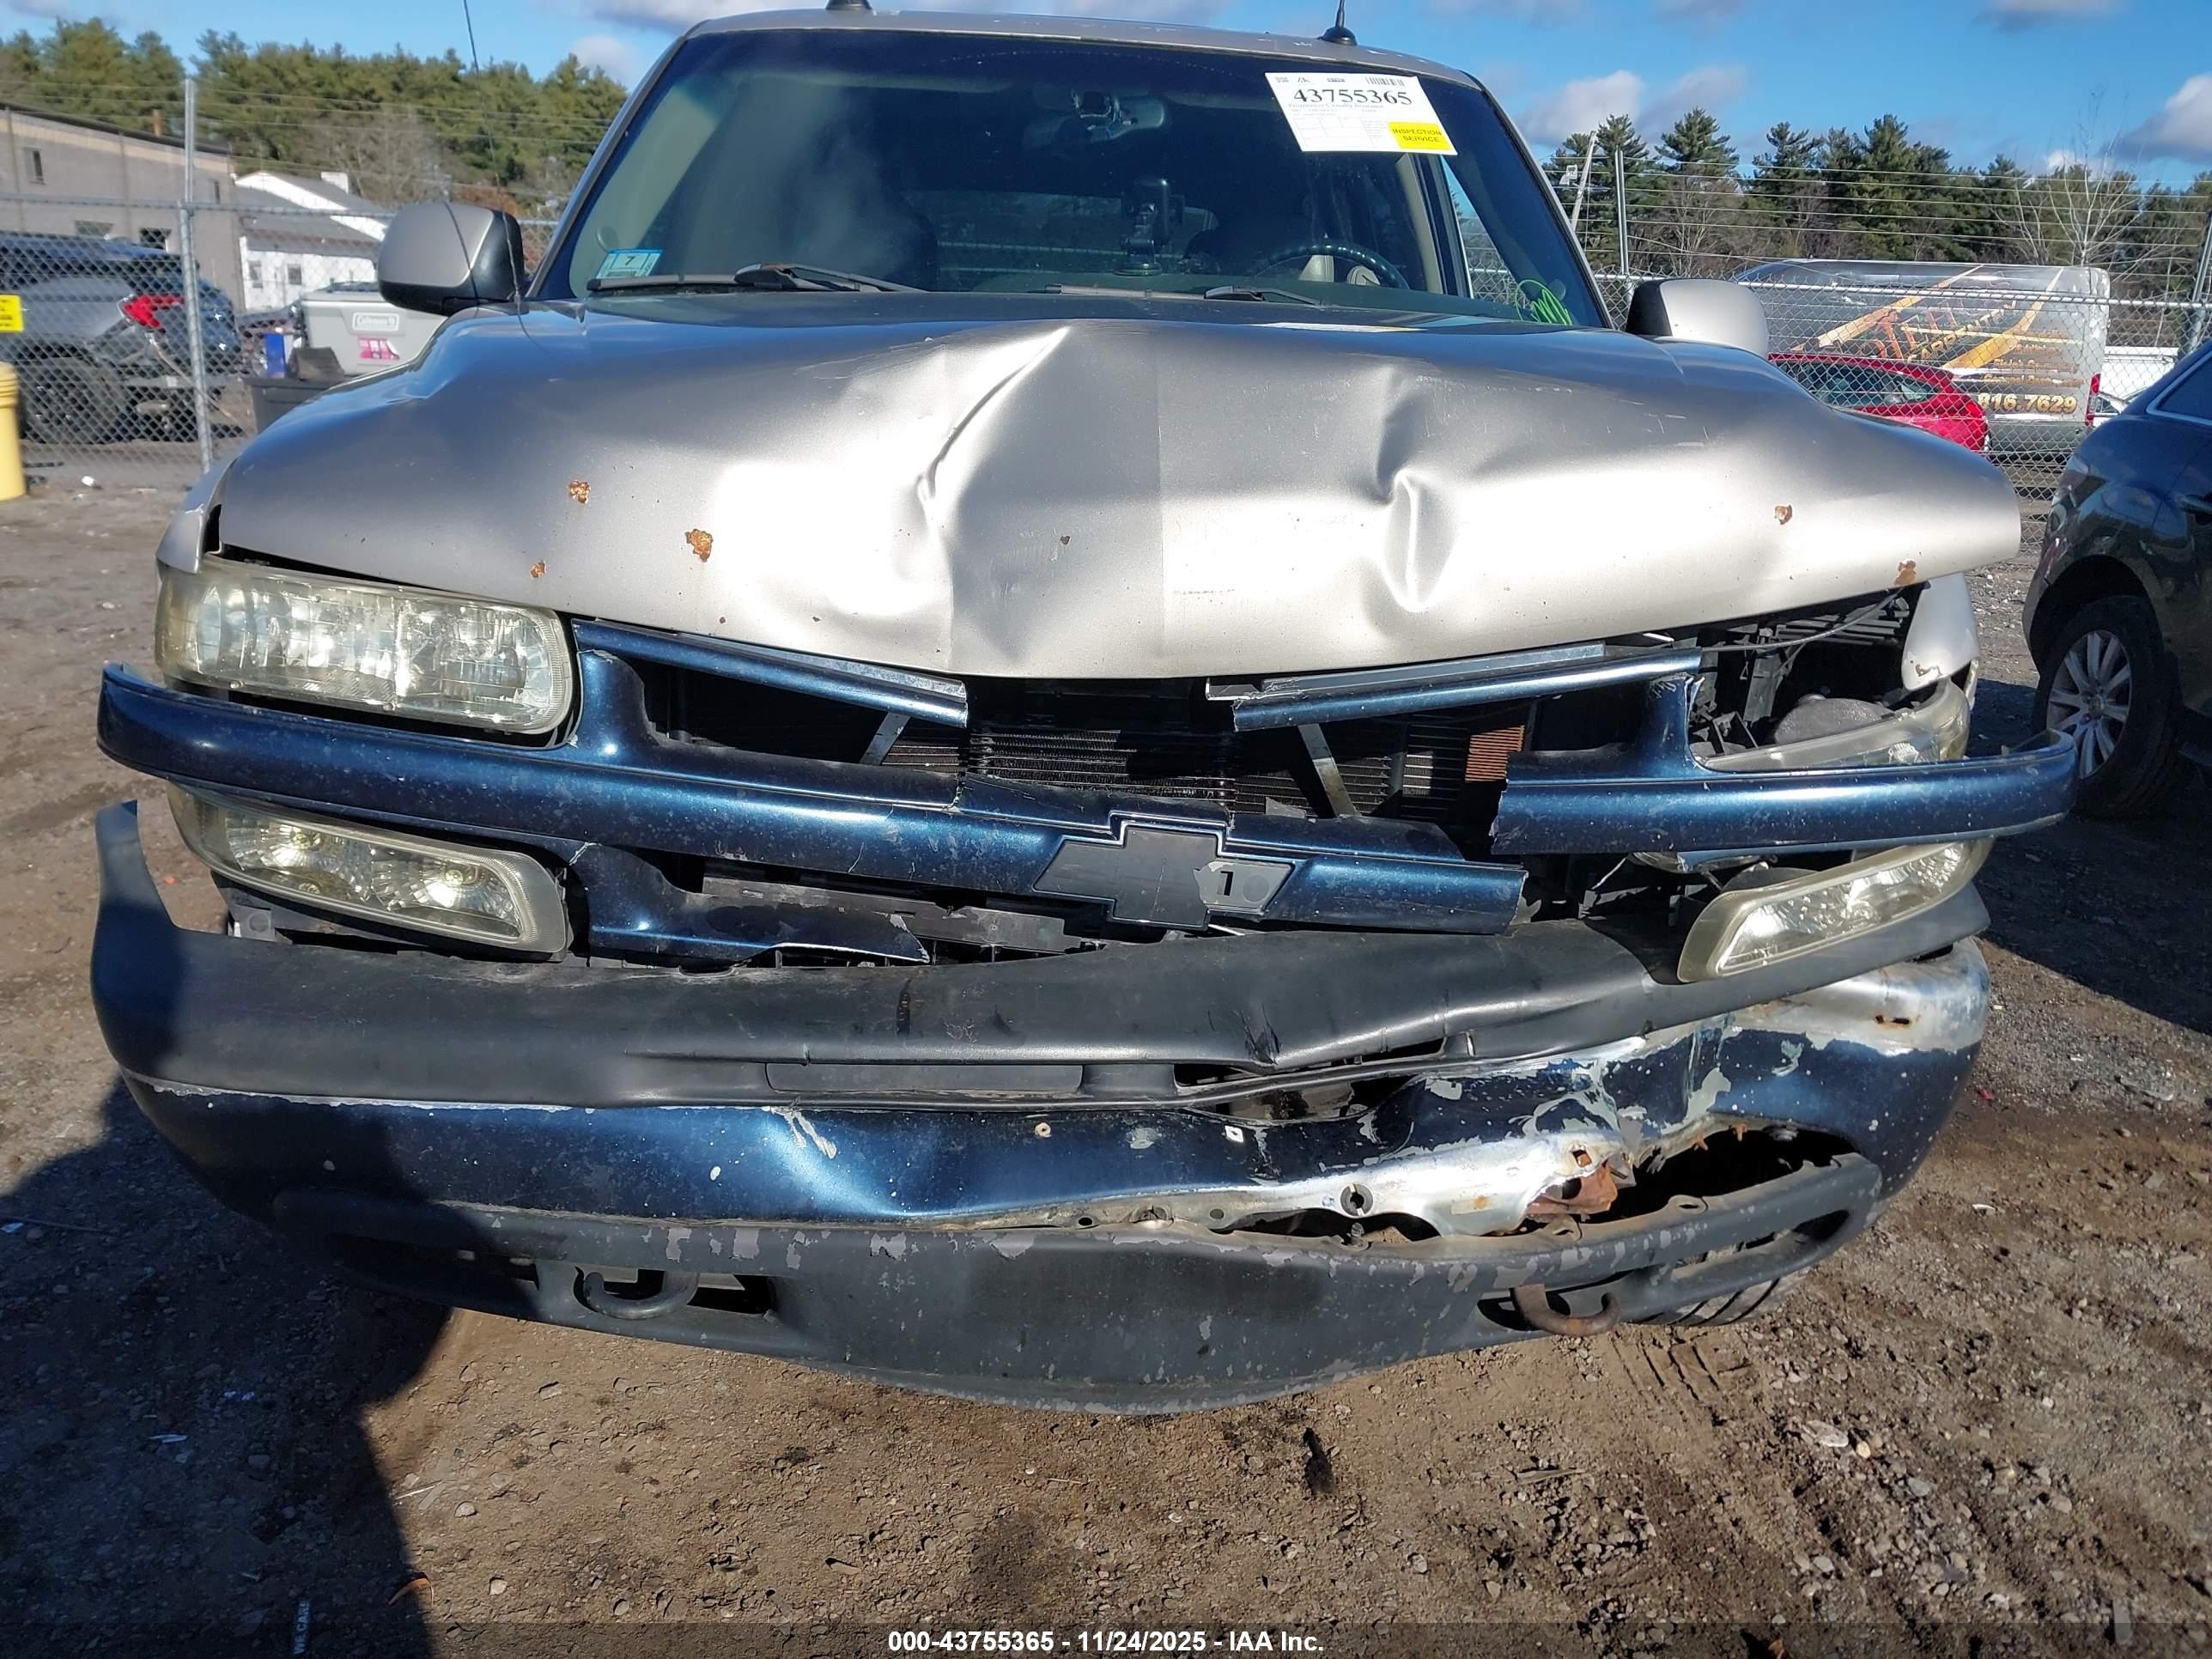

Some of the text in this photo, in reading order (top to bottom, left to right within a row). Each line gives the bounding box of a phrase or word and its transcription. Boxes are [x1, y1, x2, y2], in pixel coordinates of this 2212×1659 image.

[1293, 88, 1412, 105] 43755365
[1391, 128, 1443, 137] INSPECTION
[624, 255, 635, 266] 7
